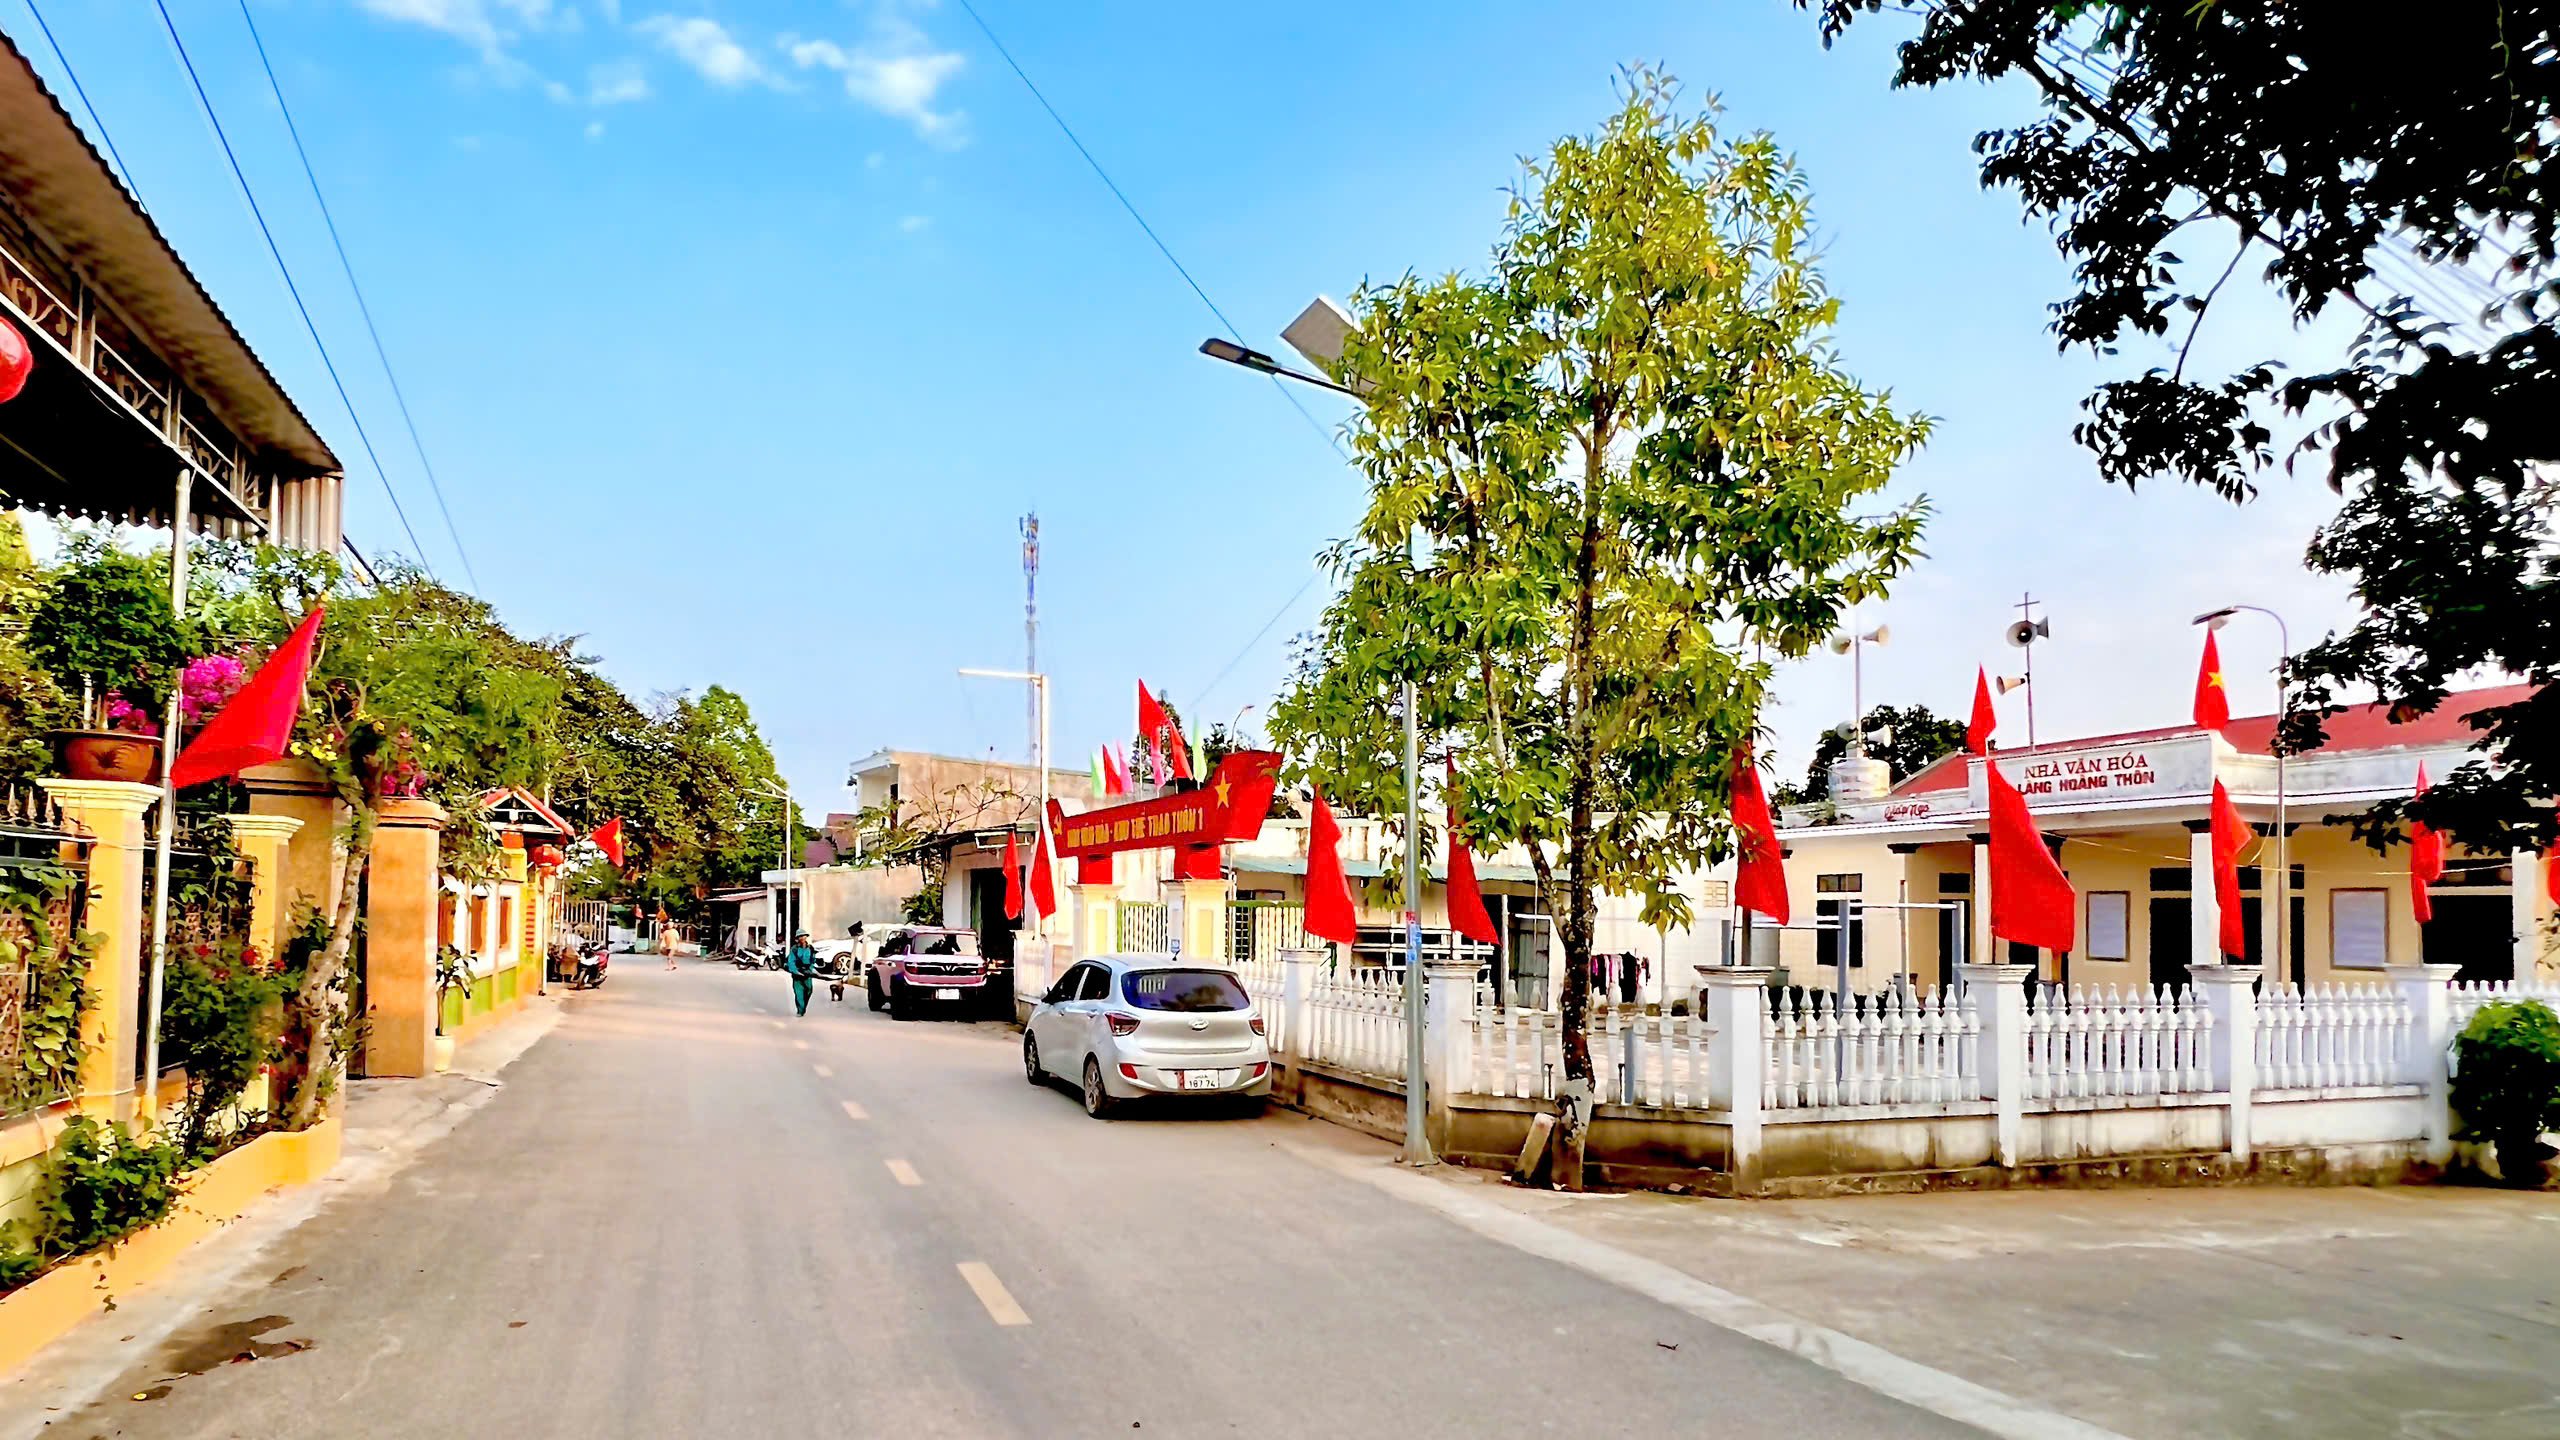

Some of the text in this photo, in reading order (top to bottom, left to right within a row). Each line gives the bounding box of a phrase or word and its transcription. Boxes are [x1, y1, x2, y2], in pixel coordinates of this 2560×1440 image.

[2024, 751, 2148, 779] NHÀ VĂN HÓA
[2114, 769, 2155, 787] THÔN
